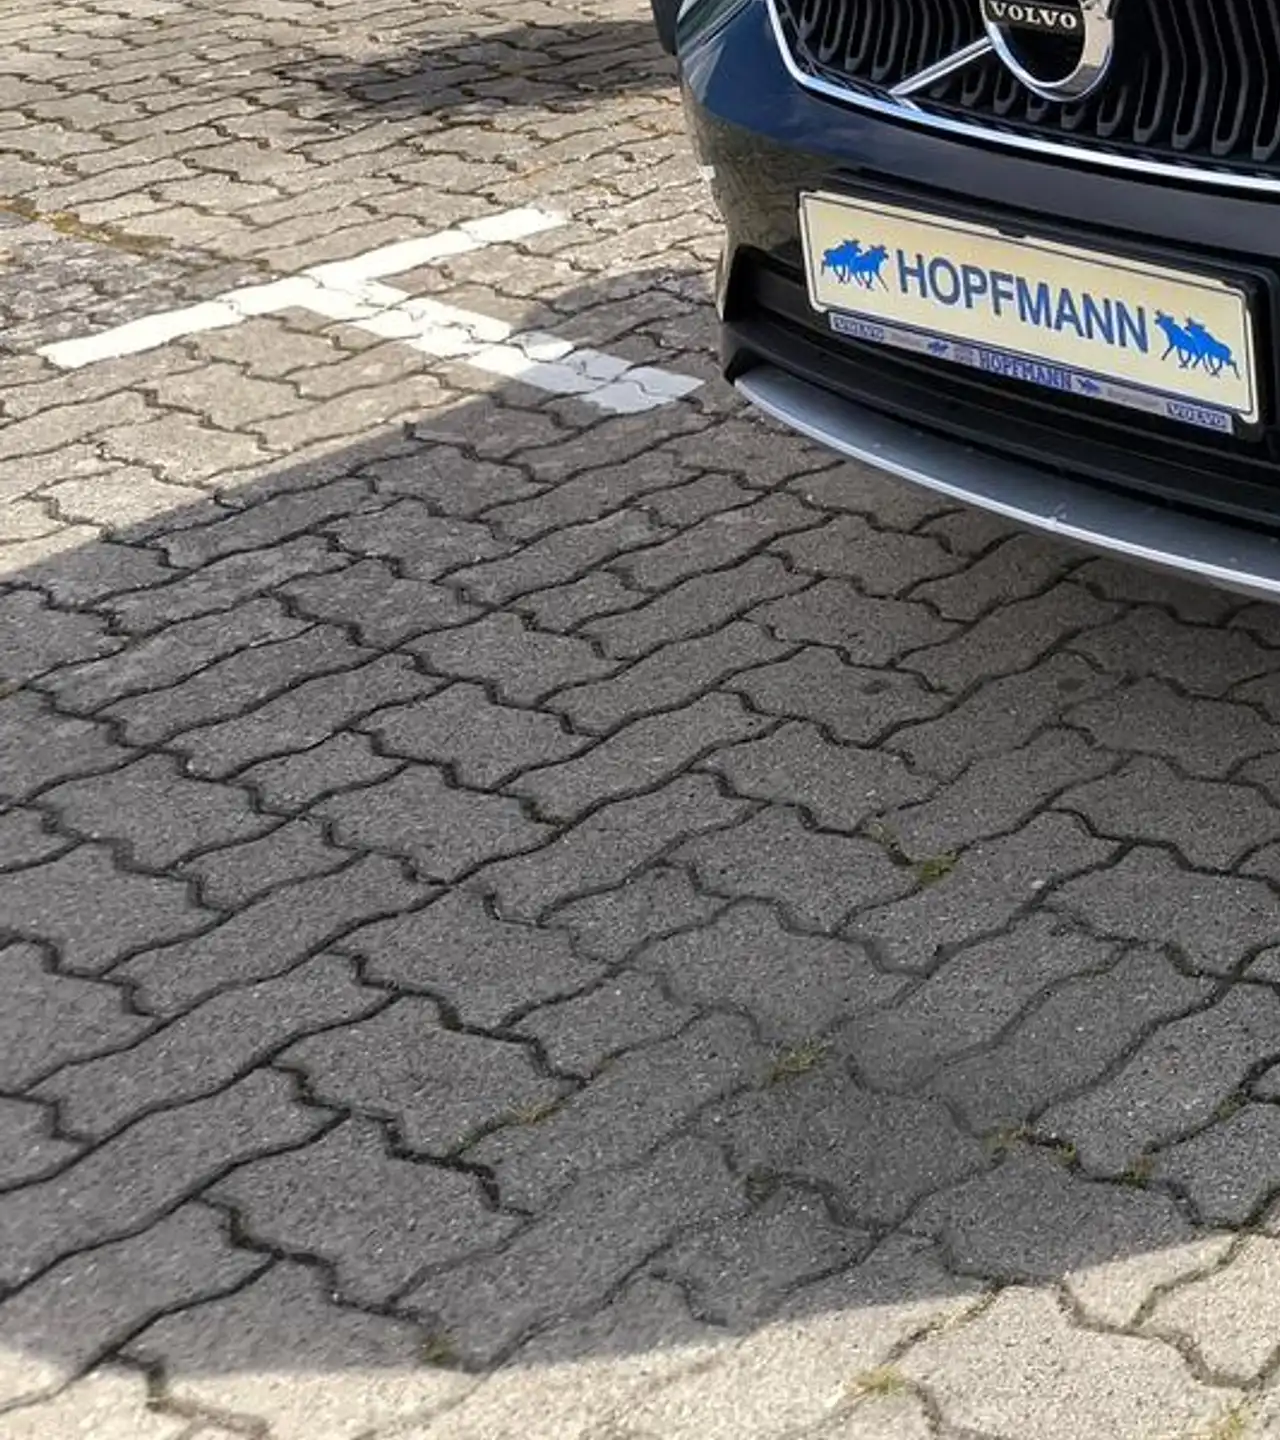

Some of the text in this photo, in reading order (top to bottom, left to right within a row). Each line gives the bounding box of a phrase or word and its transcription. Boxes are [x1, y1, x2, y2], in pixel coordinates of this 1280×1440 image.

[988, 0, 1077, 29] VOLVO
[896, 249, 1149, 354] HOPFMANN
[980, 348, 1073, 392] HOPFMANN
